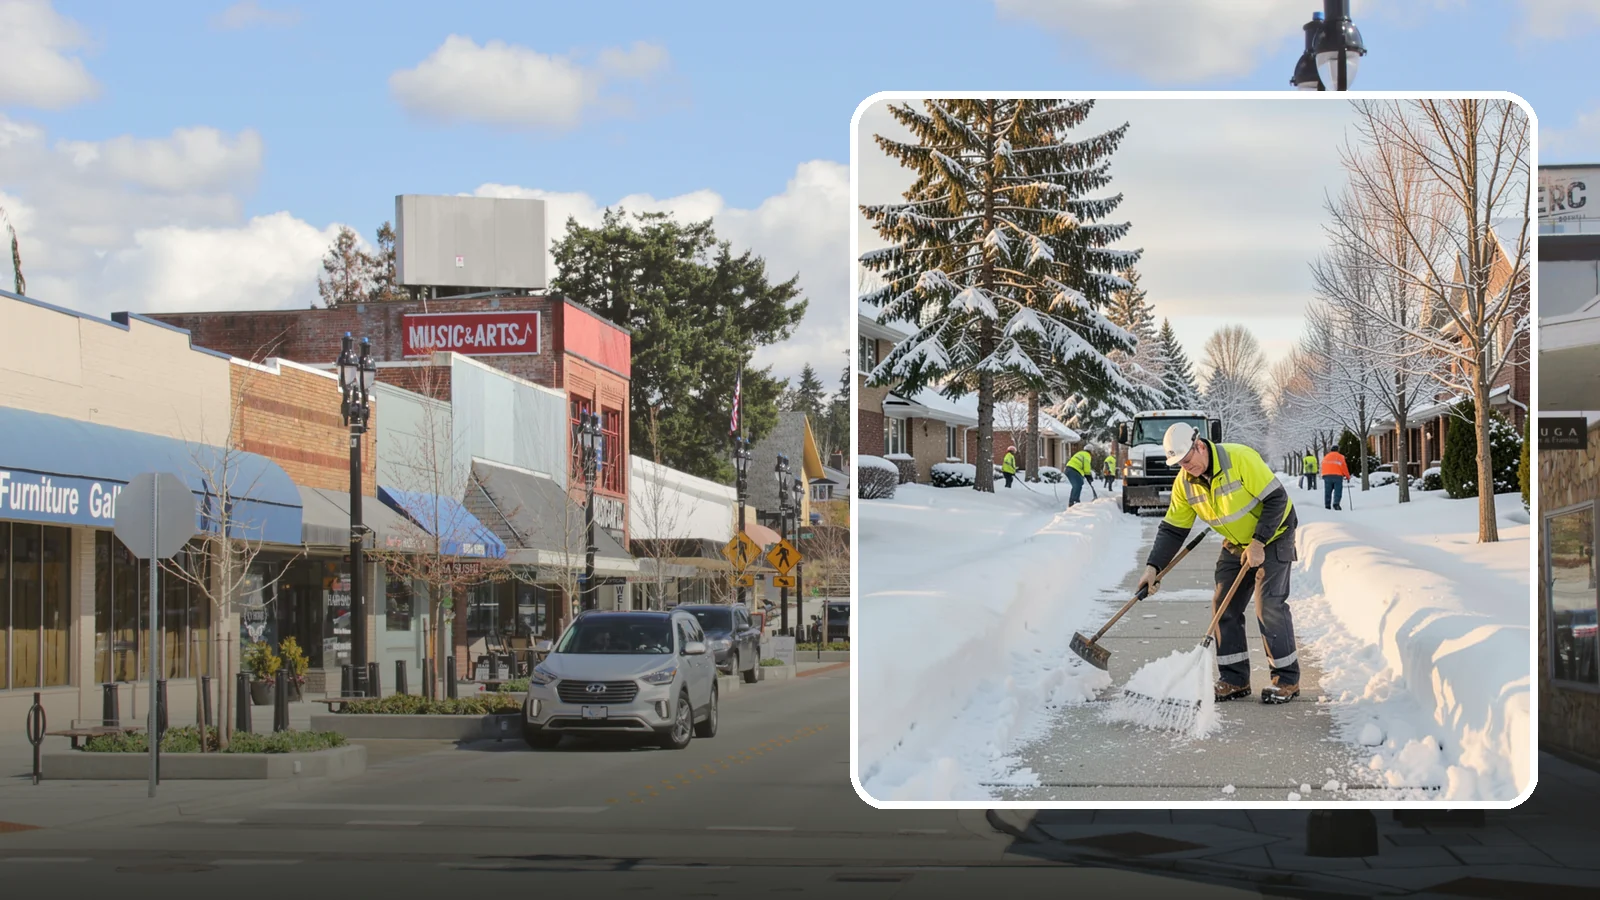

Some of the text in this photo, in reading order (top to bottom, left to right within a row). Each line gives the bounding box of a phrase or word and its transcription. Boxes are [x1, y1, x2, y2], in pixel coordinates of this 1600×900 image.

[1540, 427, 1577, 436] UGA
[0, 471, 122, 518] Furniture Gal
